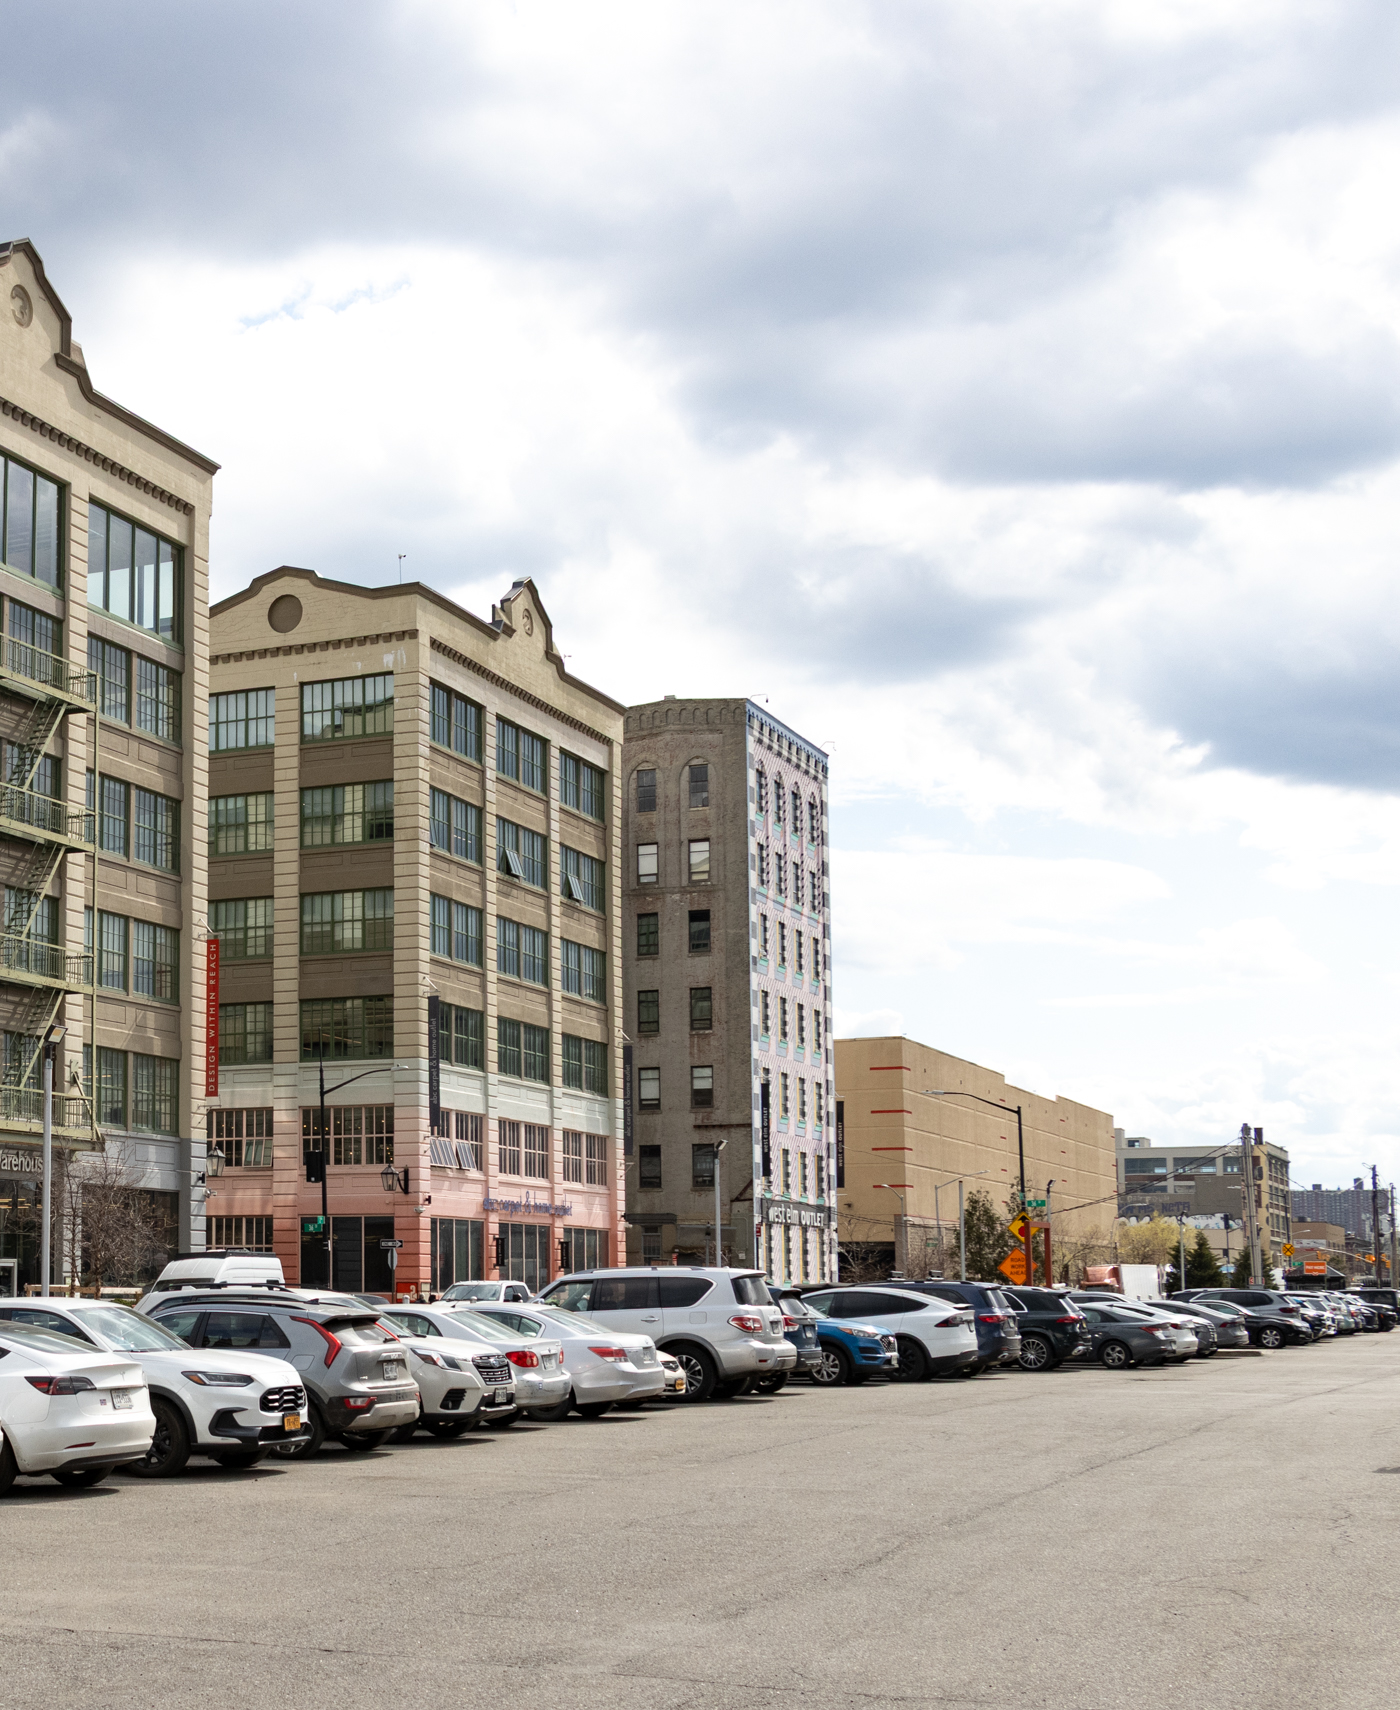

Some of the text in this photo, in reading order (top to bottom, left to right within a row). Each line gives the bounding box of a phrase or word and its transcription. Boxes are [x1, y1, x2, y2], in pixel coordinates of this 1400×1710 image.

[208, 944, 217, 1092] DESIGN WITHIN REACH
[429, 1018, 437, 1037] outlet
[429, 1039, 437, 1061] home
[431, 1069, 439, 1091] carpet
[768, 1203, 825, 1227] west elm OUTLET
